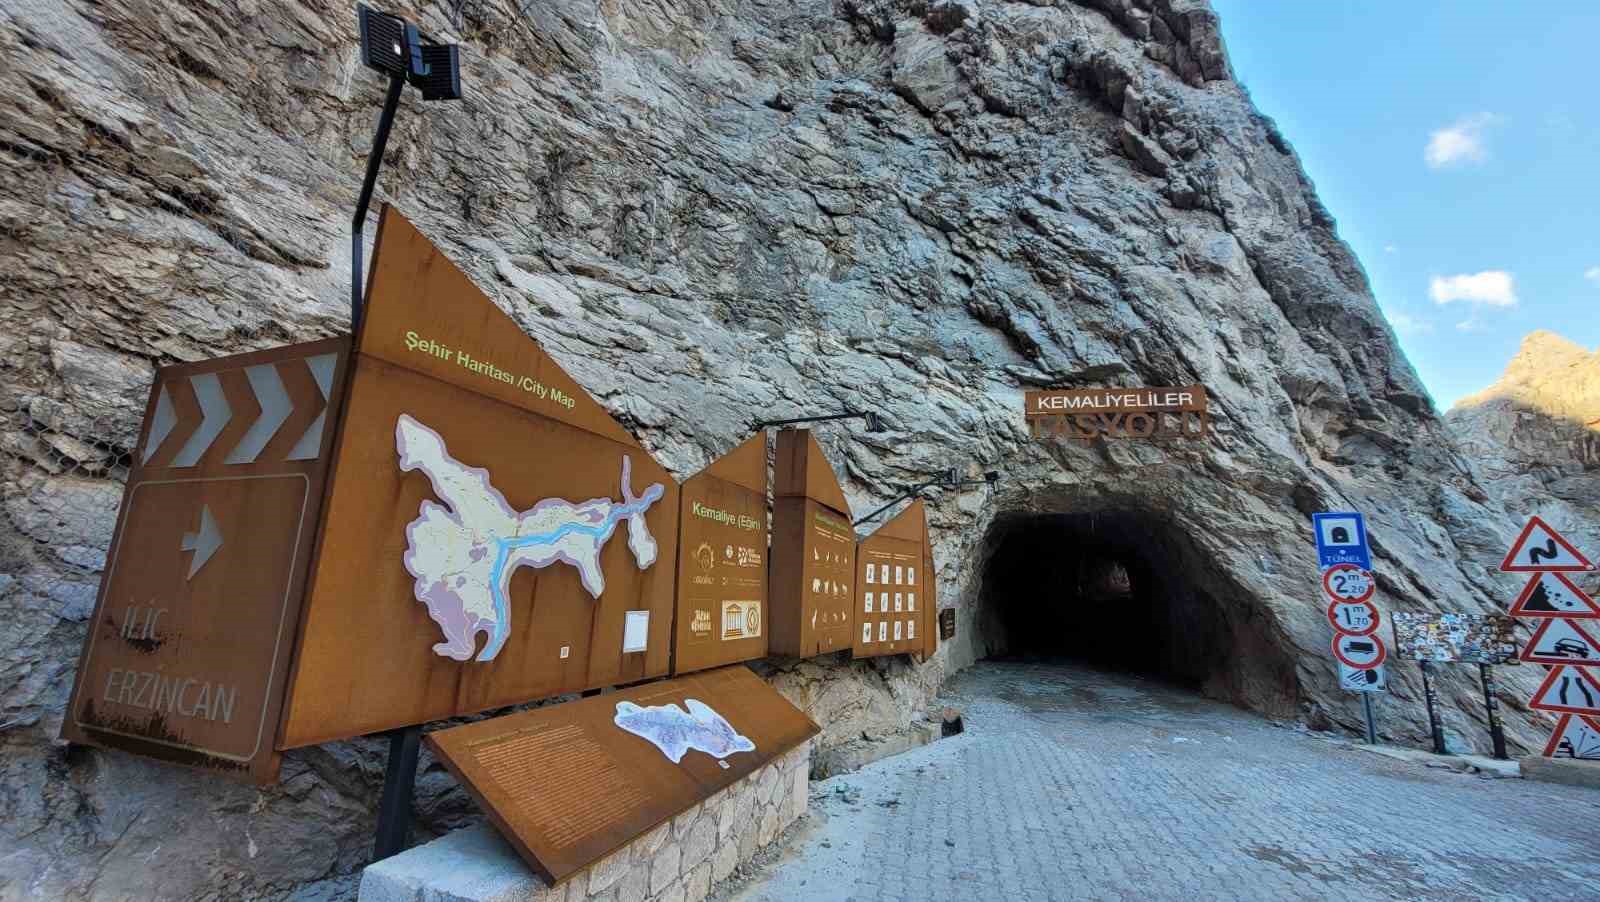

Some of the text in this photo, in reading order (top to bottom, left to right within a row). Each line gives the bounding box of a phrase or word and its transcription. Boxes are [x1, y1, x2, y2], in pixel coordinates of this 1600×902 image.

[405, 331, 453, 360] Şehir
[456, 350, 514, 385] Haritası
[550, 387, 576, 410] Map
[1037, 391, 1193, 409] KEMALİYELİLER
[692, 501, 736, 526] Kemaliye
[1333, 575, 1349, 593] 2
[1343, 606, 1352, 625] 1
[104, 664, 238, 722] ERZİNCAN
